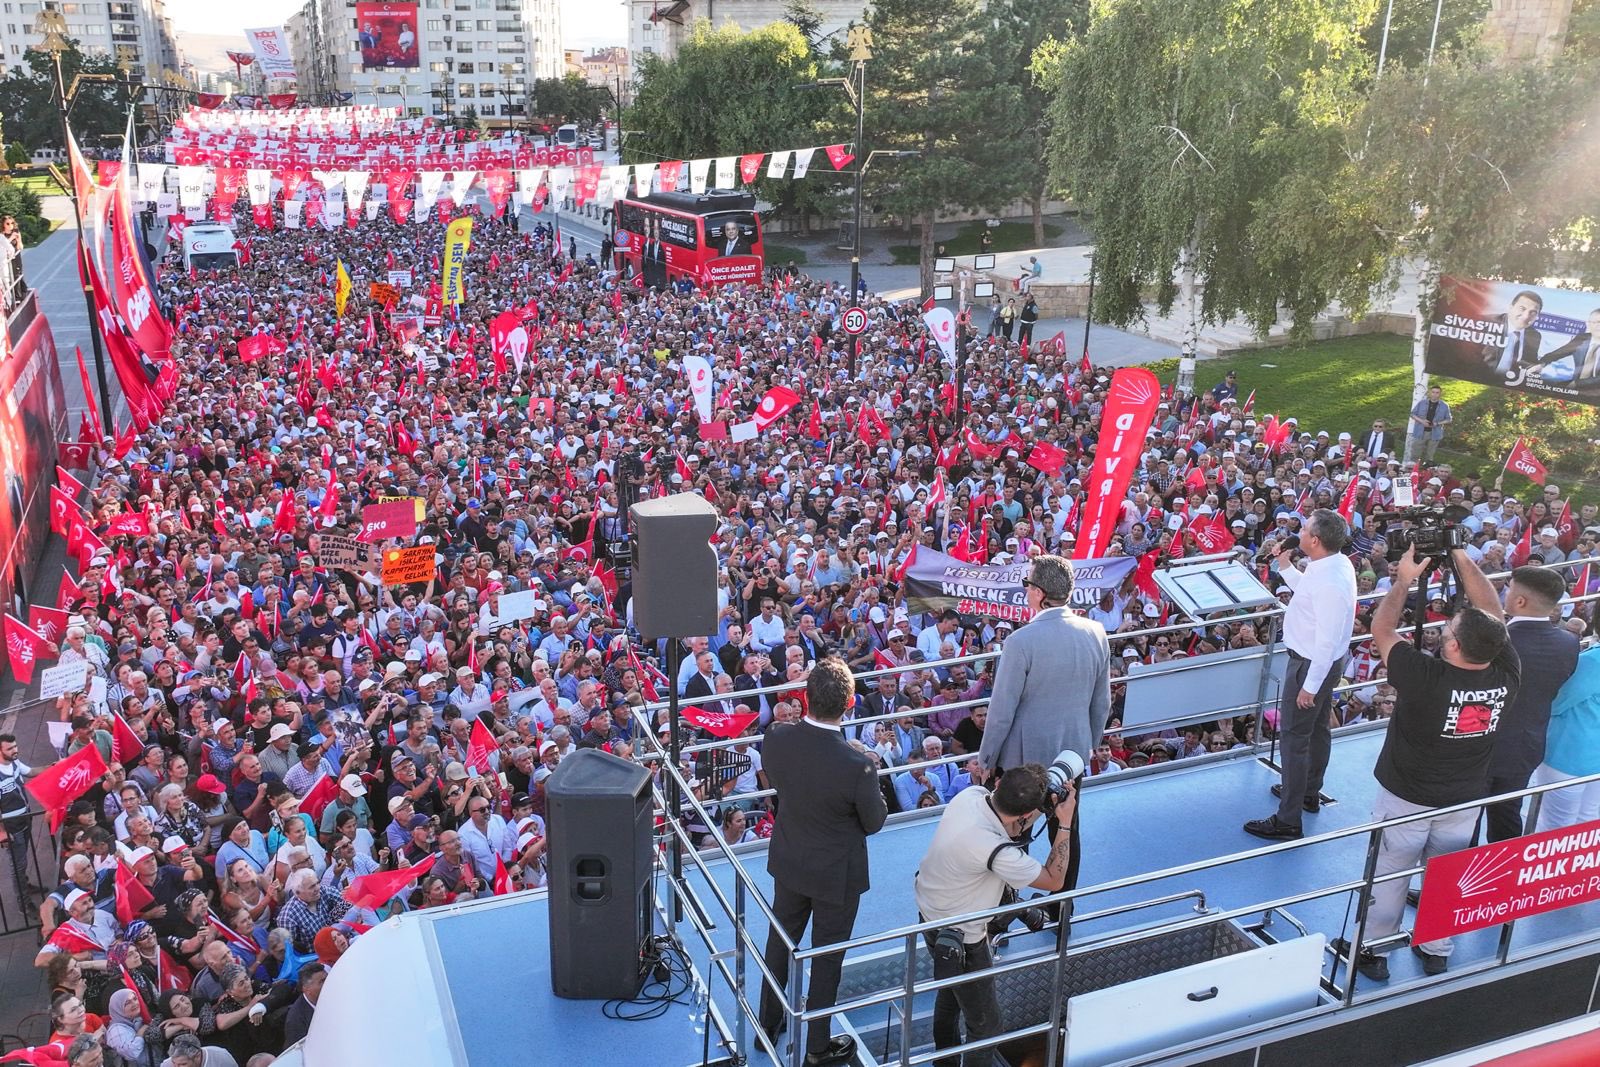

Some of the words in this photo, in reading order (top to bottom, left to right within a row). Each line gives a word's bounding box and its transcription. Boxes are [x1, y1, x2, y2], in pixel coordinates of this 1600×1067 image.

[184, 185, 201, 193] CHP
[451, 242, 464, 263] SEN
[711, 266, 730, 274] ÖNCE
[730, 264, 756, 272] ADALET
[847, 315, 863, 328] 50
[1444, 312, 1504, 334] SİVAS'IN
[1435, 323, 1508, 348] GURURU
[1552, 386, 1579, 395] KOLLARI
[1515, 460, 1537, 474] CHP
[332, 536, 370, 549] MEMLEKET
[1197, 532, 1214, 549] CHP
[941, 581, 1009, 604] MADENE
[1450, 686, 1508, 704] NORTH
[1443, 706, 1460, 731] THE
[1517, 857, 1570, 886] HALK
[1453, 893, 1534, 926] Türkiye'nin
[1537, 879, 1587, 906] Birinci
